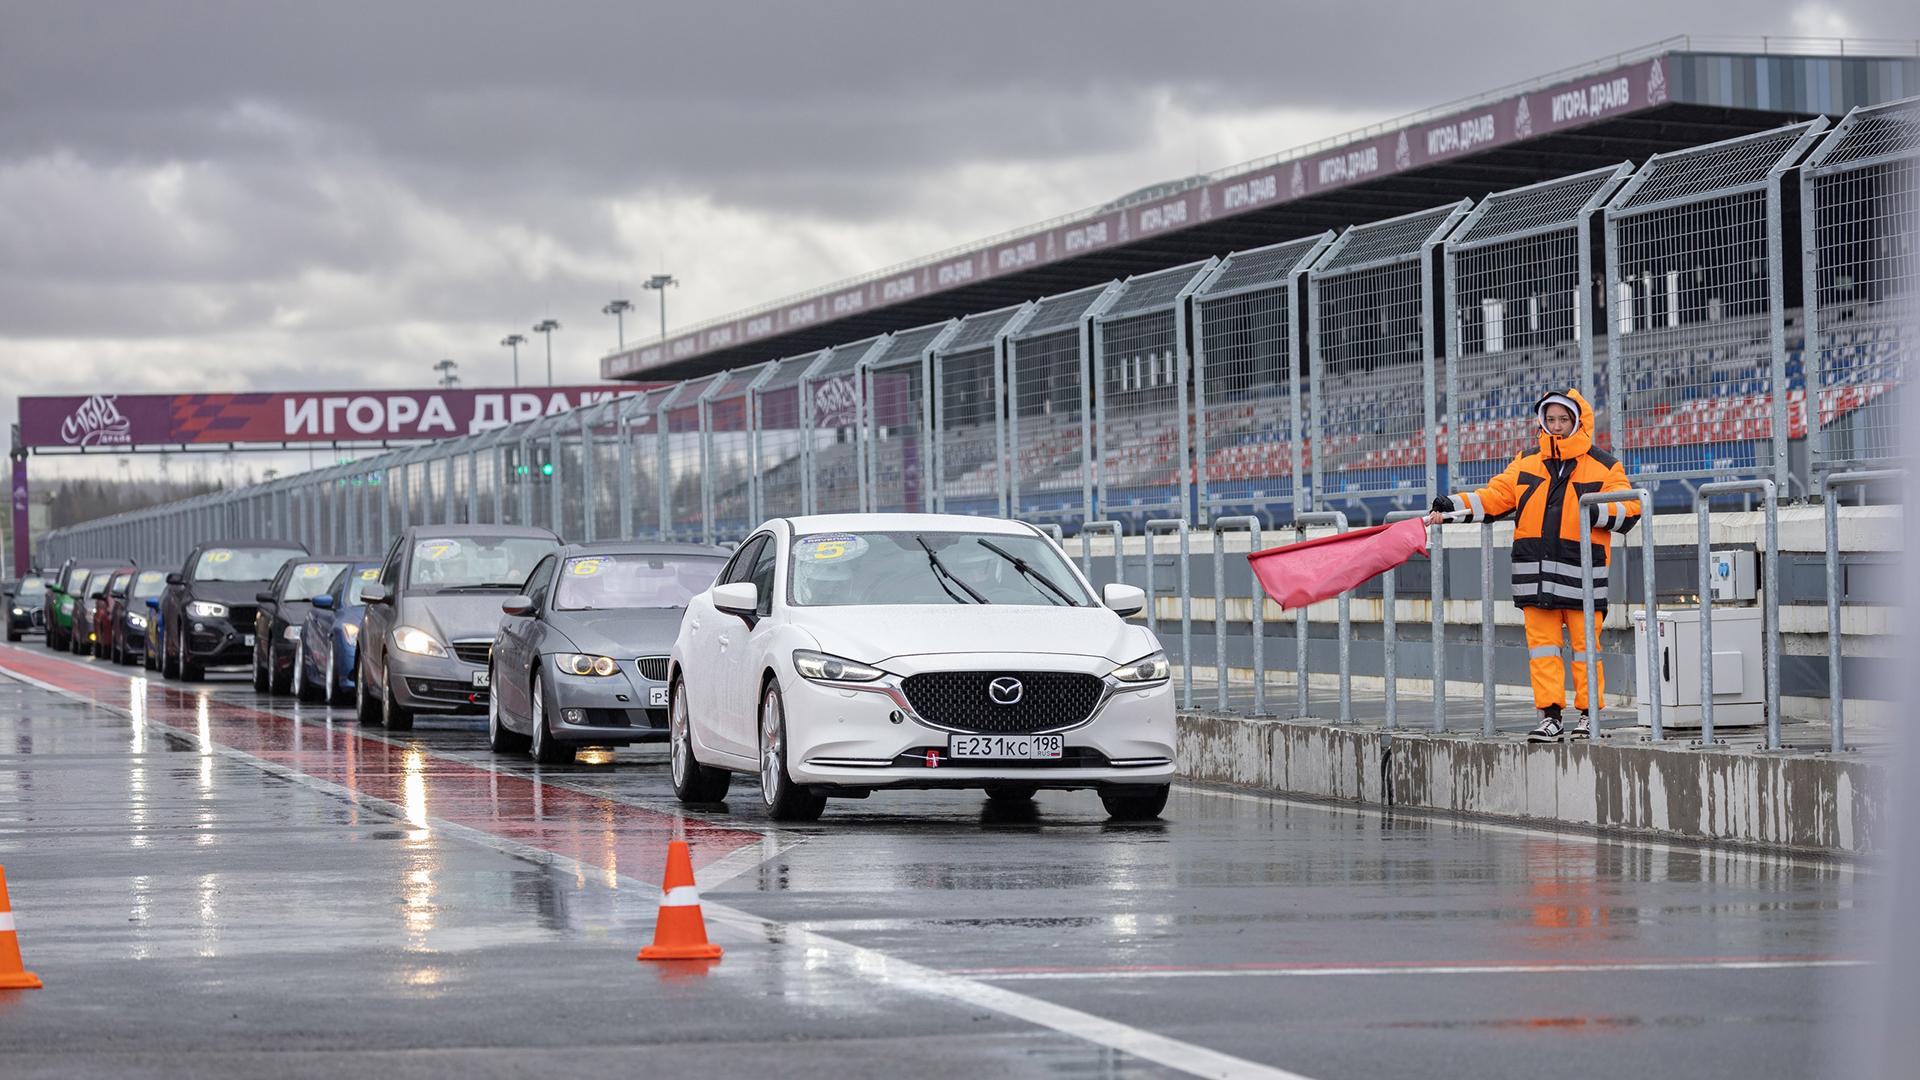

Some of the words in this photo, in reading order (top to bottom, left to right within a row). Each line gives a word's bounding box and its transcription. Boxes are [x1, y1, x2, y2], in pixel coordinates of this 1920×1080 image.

[1552, 89, 1588, 123] ИГОРА
[1427, 125, 1459, 156] ИГОРА
[284, 396, 457, 434] ИГОРА
[207, 551, 231, 564] 10
[431, 545, 449, 560] 7
[815, 541, 845, 559] 5
[574, 560, 600, 575] 6
[957, 737, 1028, 756] Е231КС
[1033, 737, 1058, 750] 198
